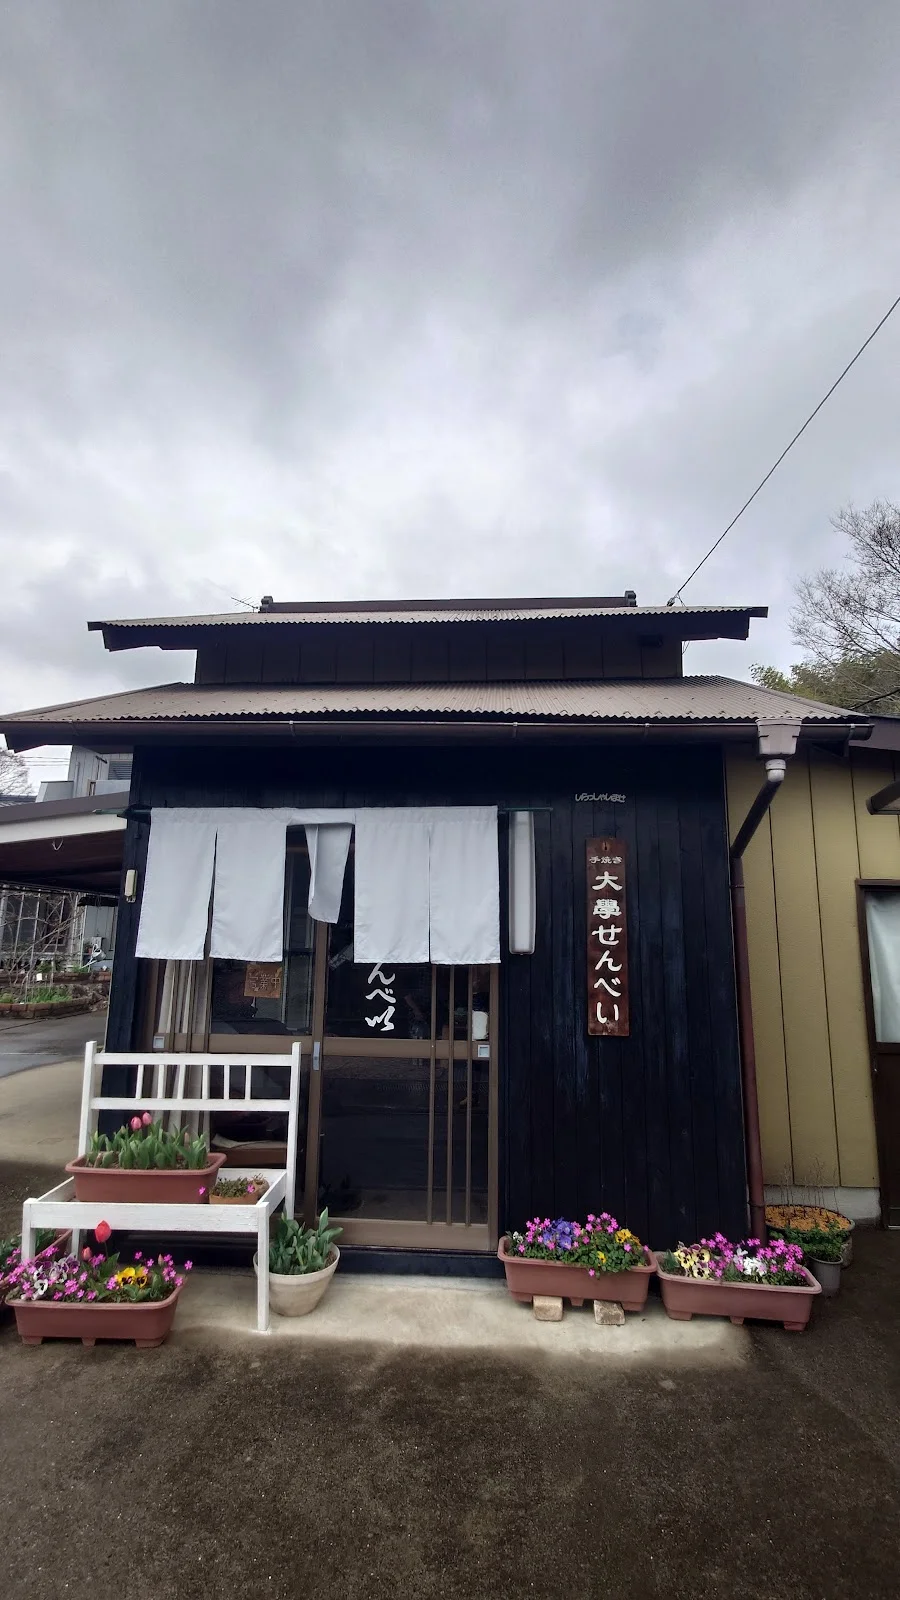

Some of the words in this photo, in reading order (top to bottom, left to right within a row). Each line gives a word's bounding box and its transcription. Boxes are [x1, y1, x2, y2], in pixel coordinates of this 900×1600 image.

[589, 855, 623, 864] 手焼き
[591, 870, 623, 1024] 大學せんべい
